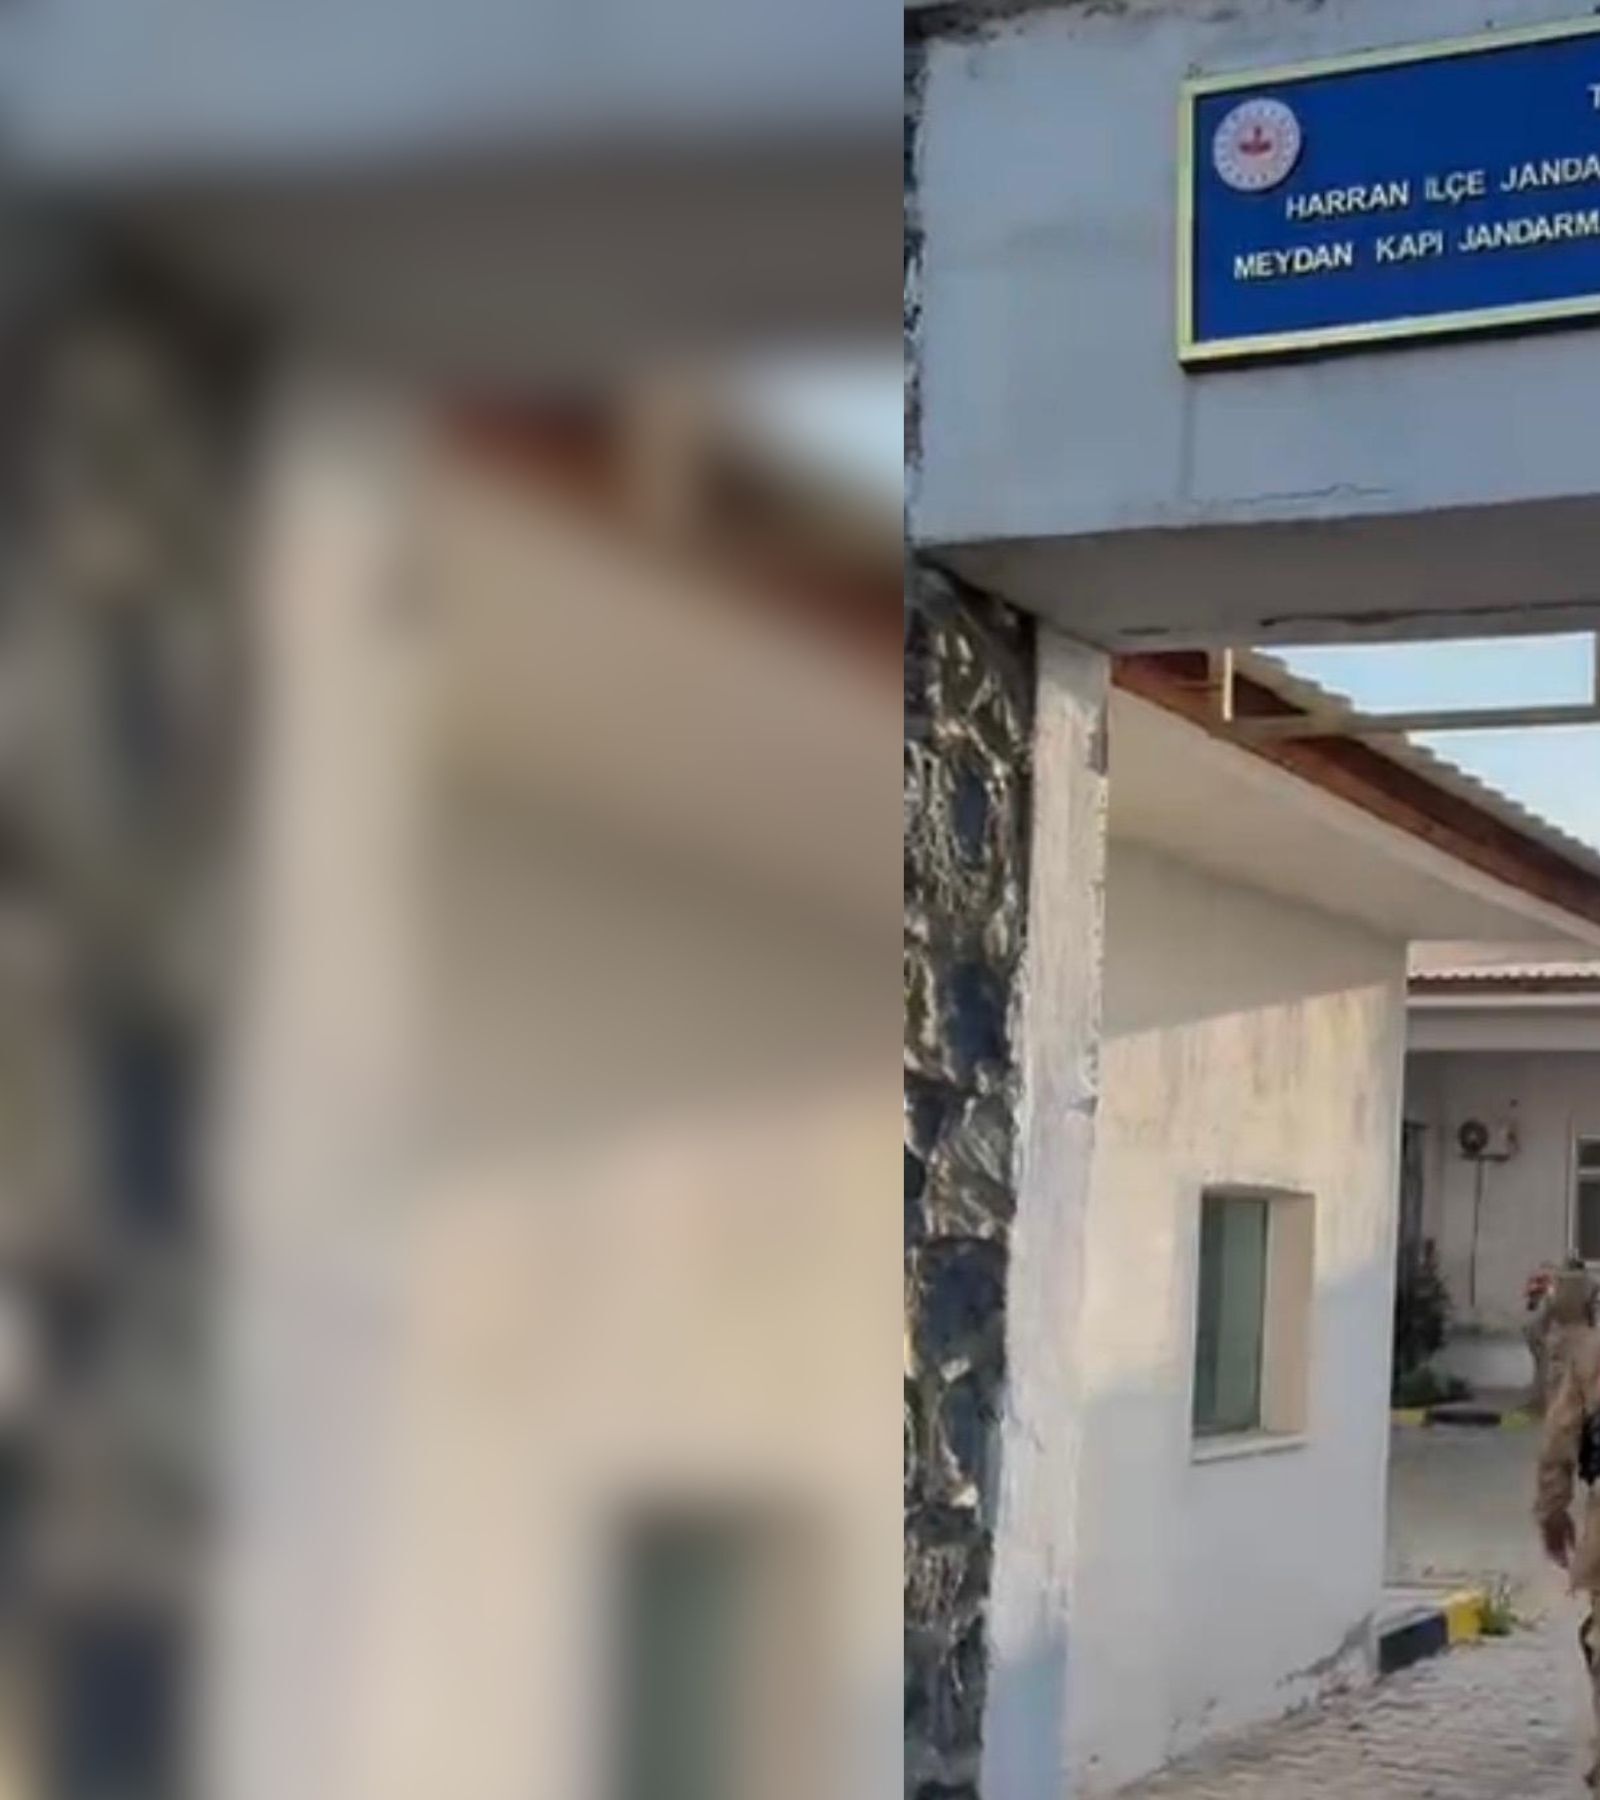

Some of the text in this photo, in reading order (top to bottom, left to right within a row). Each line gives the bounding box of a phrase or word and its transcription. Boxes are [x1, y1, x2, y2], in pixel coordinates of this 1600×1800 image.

[1286, 183, 1410, 220] HARRAN
[1234, 244, 1353, 280] MEYDAN
[1376, 231, 1443, 263] KAPI
